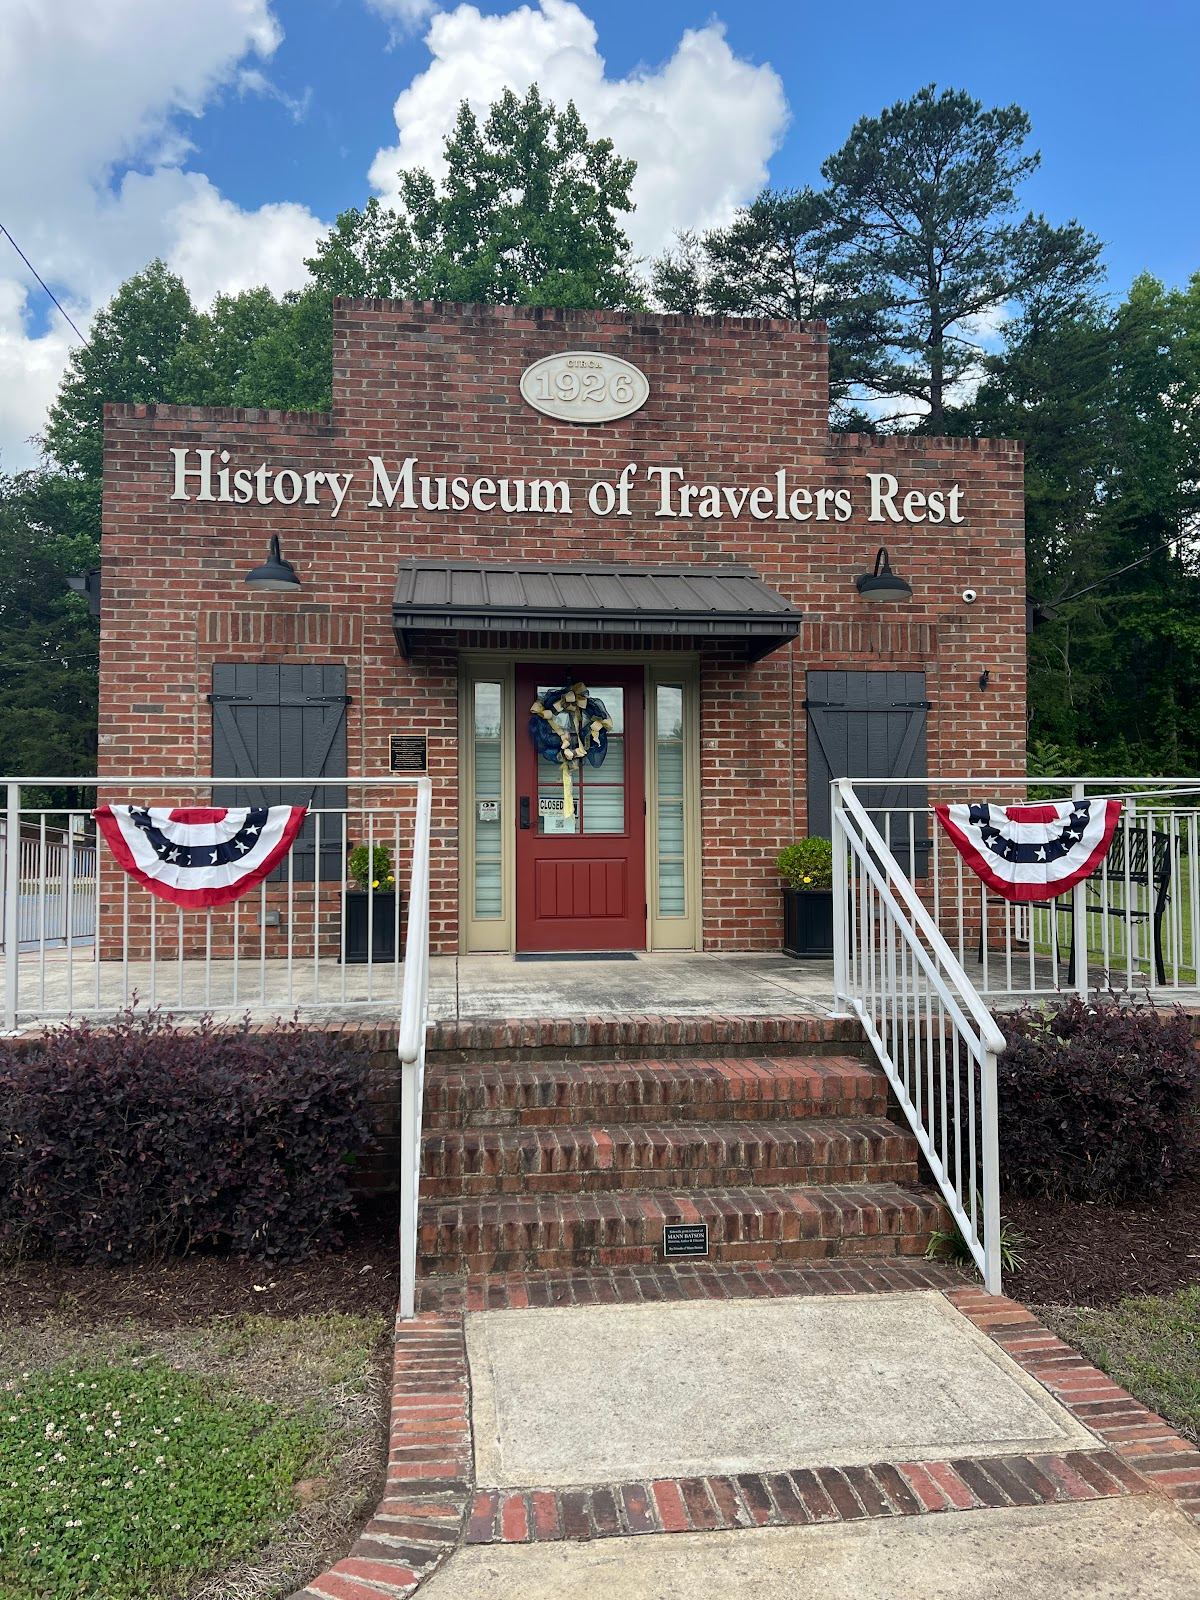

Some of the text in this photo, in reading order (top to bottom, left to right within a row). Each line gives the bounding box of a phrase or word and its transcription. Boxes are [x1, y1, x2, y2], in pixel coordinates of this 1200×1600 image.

[567, 360, 603, 369] CIRCA
[536, 370, 634, 403] 1926
[170, 447, 965, 524] History Museum of Travelers Rest
[540, 799, 564, 810] CLOSED
